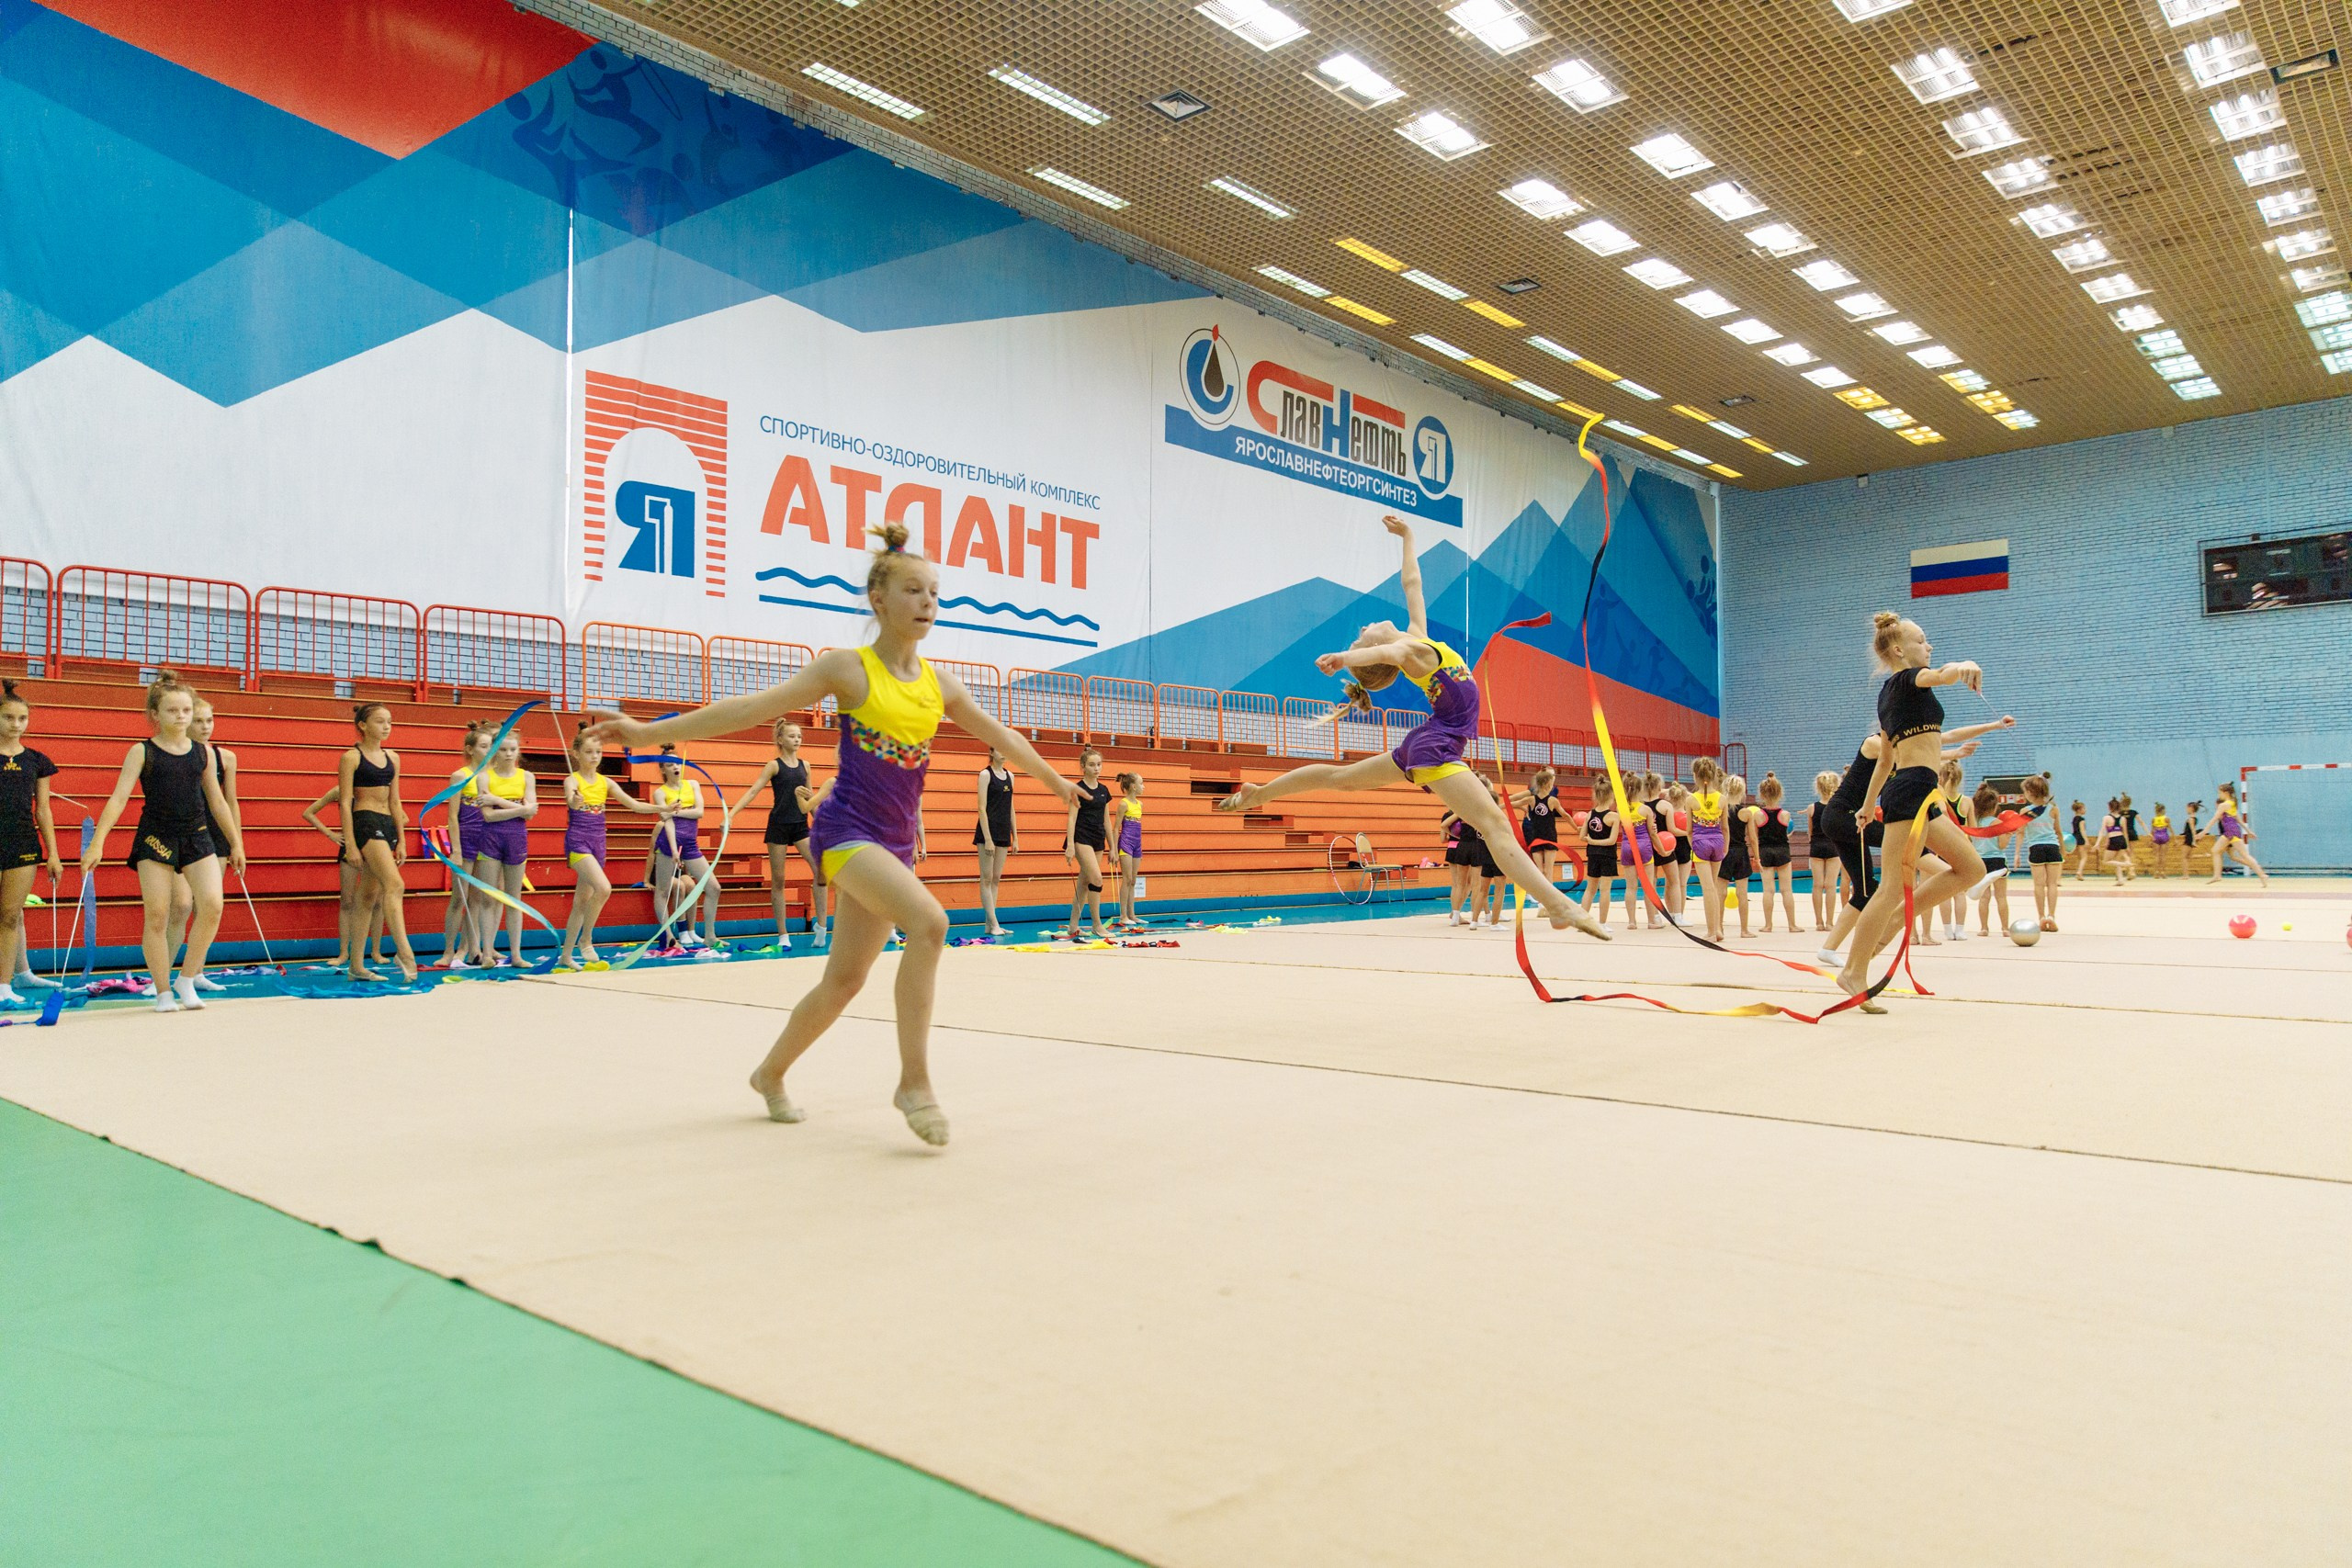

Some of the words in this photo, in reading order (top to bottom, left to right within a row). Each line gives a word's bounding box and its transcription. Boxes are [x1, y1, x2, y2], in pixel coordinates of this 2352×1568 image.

[760, 415, 1026, 491] СПОРТИВНО-ОЗДОРОВИТЕЛЬНЫЙ
[1031, 479, 1101, 510] КОМПЛЕКС
[1235, 436, 1417, 507] ЯРОСЛАВНЕФТЕОРГСИНТЕЗ
[760, 454, 1100, 590] АТЛАНТ
[144, 834, 173, 860] RUSSIA
